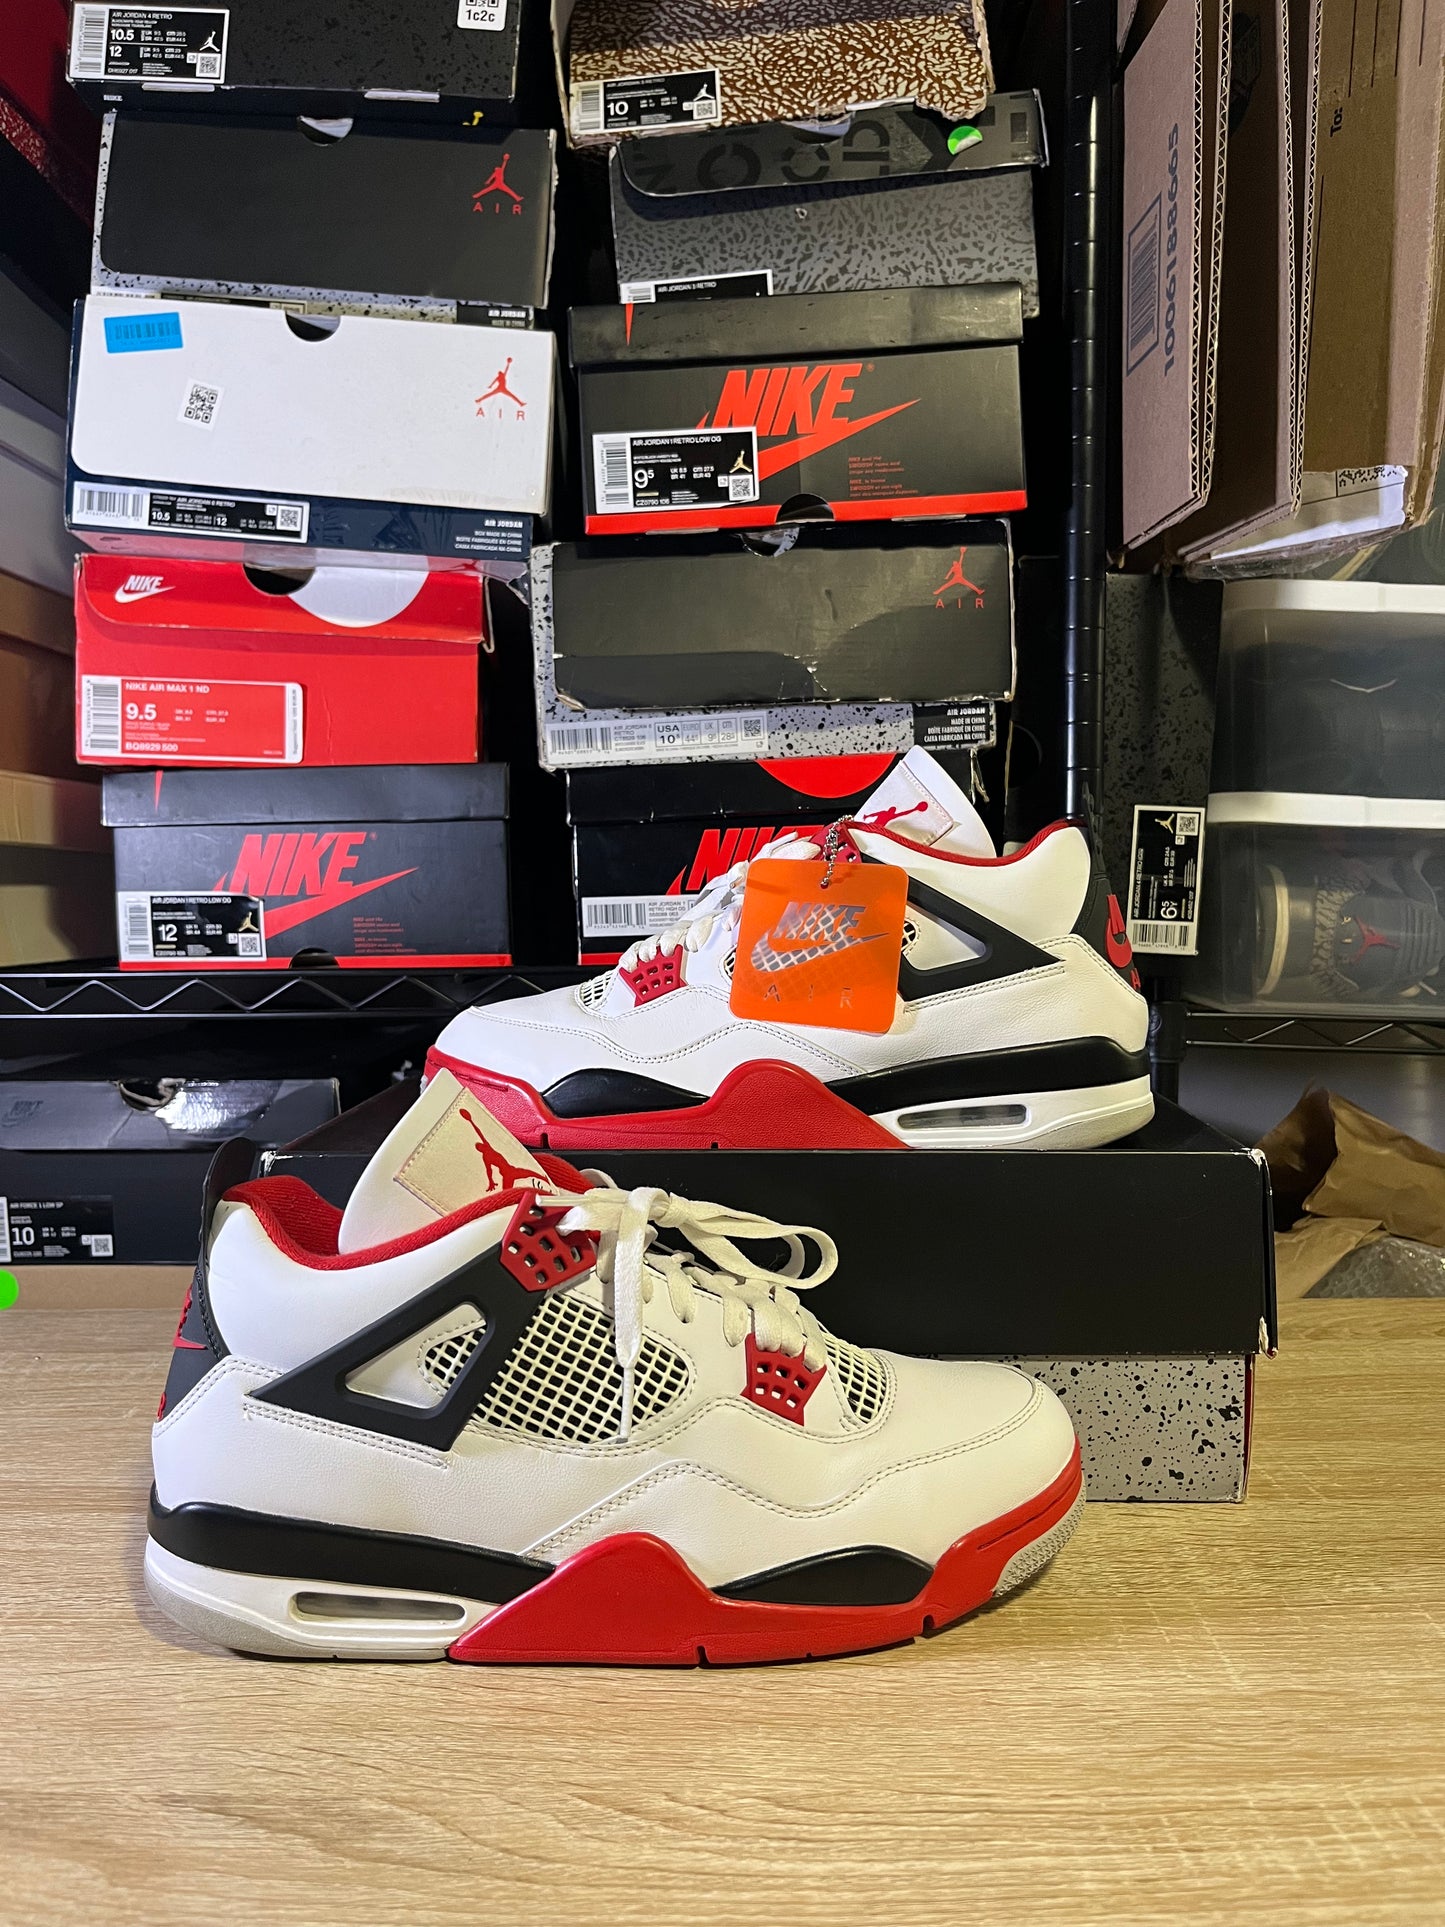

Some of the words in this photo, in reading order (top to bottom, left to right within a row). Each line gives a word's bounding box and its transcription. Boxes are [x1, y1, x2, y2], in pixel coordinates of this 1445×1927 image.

[466, 10, 495, 22] 1c2c
[110, 29, 134, 41] 10.5
[109, 45, 122, 57] 12
[607, 101, 628, 116] 10
[1330, 107, 1342, 137] To:
[472, 202, 522, 215] AIR
[1164, 123, 1178, 376] 1006188665
[712, 363, 863, 436] NIKE
[476, 407, 526, 421] AIR
[643, 438, 670, 446] JORDAN
[152, 511, 170, 521] 10.5
[216, 517, 227, 526] 12
[123, 575, 164, 591] NIKE
[936, 598, 985, 609] AIR
[125, 682, 147, 691] NIKE
[149, 683, 164, 691] AIR
[166, 684, 187, 692] MAX
[126, 703, 157, 720] 9.5
[960, 707, 986, 715] JORDAN
[230, 832, 366, 896] NIKE
[772, 902, 866, 942] NIKE
[158, 924, 178, 941] 12
[764, 984, 853, 1009] AIR
[11, 1227, 35, 1245] 10
